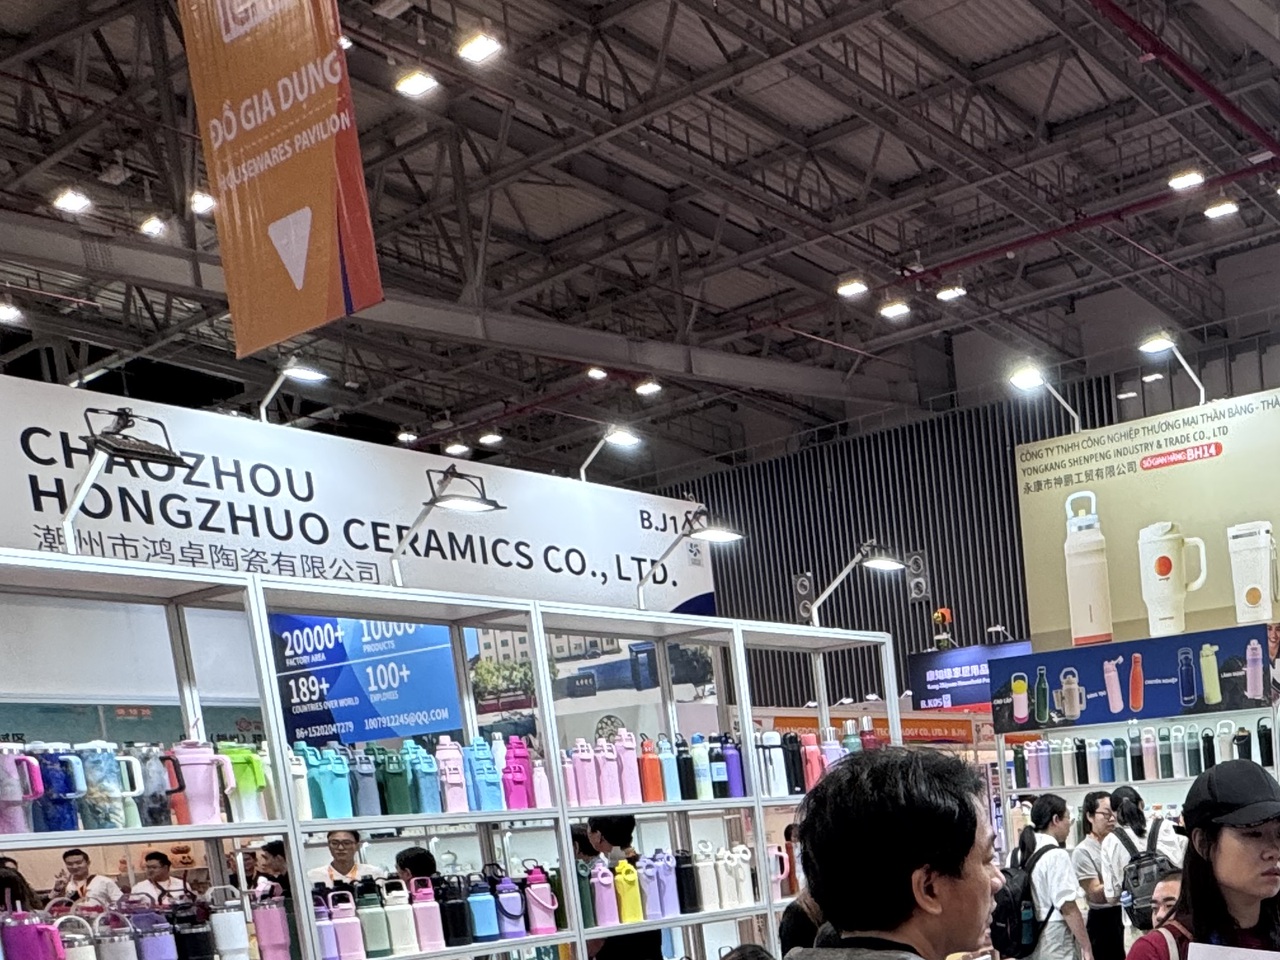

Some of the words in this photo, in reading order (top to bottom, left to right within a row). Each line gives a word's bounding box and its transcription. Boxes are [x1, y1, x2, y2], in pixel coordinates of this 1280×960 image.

[240, 88, 276, 130] GIA
[277, 50, 342, 111] DỤNG
[218, 139, 293, 191] HOUSEWARES
[293, 109, 351, 153] PAVILION
[1021, 461, 1067, 478] YONGKANG
[1069, 451, 1112, 468] SHENPENG
[1113, 441, 1155, 459] INDUSTRY
[1157, 439, 1163, 449] &
[1164, 433, 1191, 447] TRADE
[1212, 425, 1229, 438] LTD
[1045, 447, 1056, 458] TY
[1056, 441, 1080, 456] TNHH
[1081, 435, 1106, 451] CÔNG
[1186, 443, 1216, 461] BH14
[28, 474, 330, 545] HONGZHUO
[342, 516, 535, 570] CERAMICS
[544, 545, 608, 586] CO.,
[616, 553, 679, 588] LTD.
[281, 622, 345, 657] 20000+
[288, 675, 331, 704] 189+
[365, 662, 411, 692] 100+
